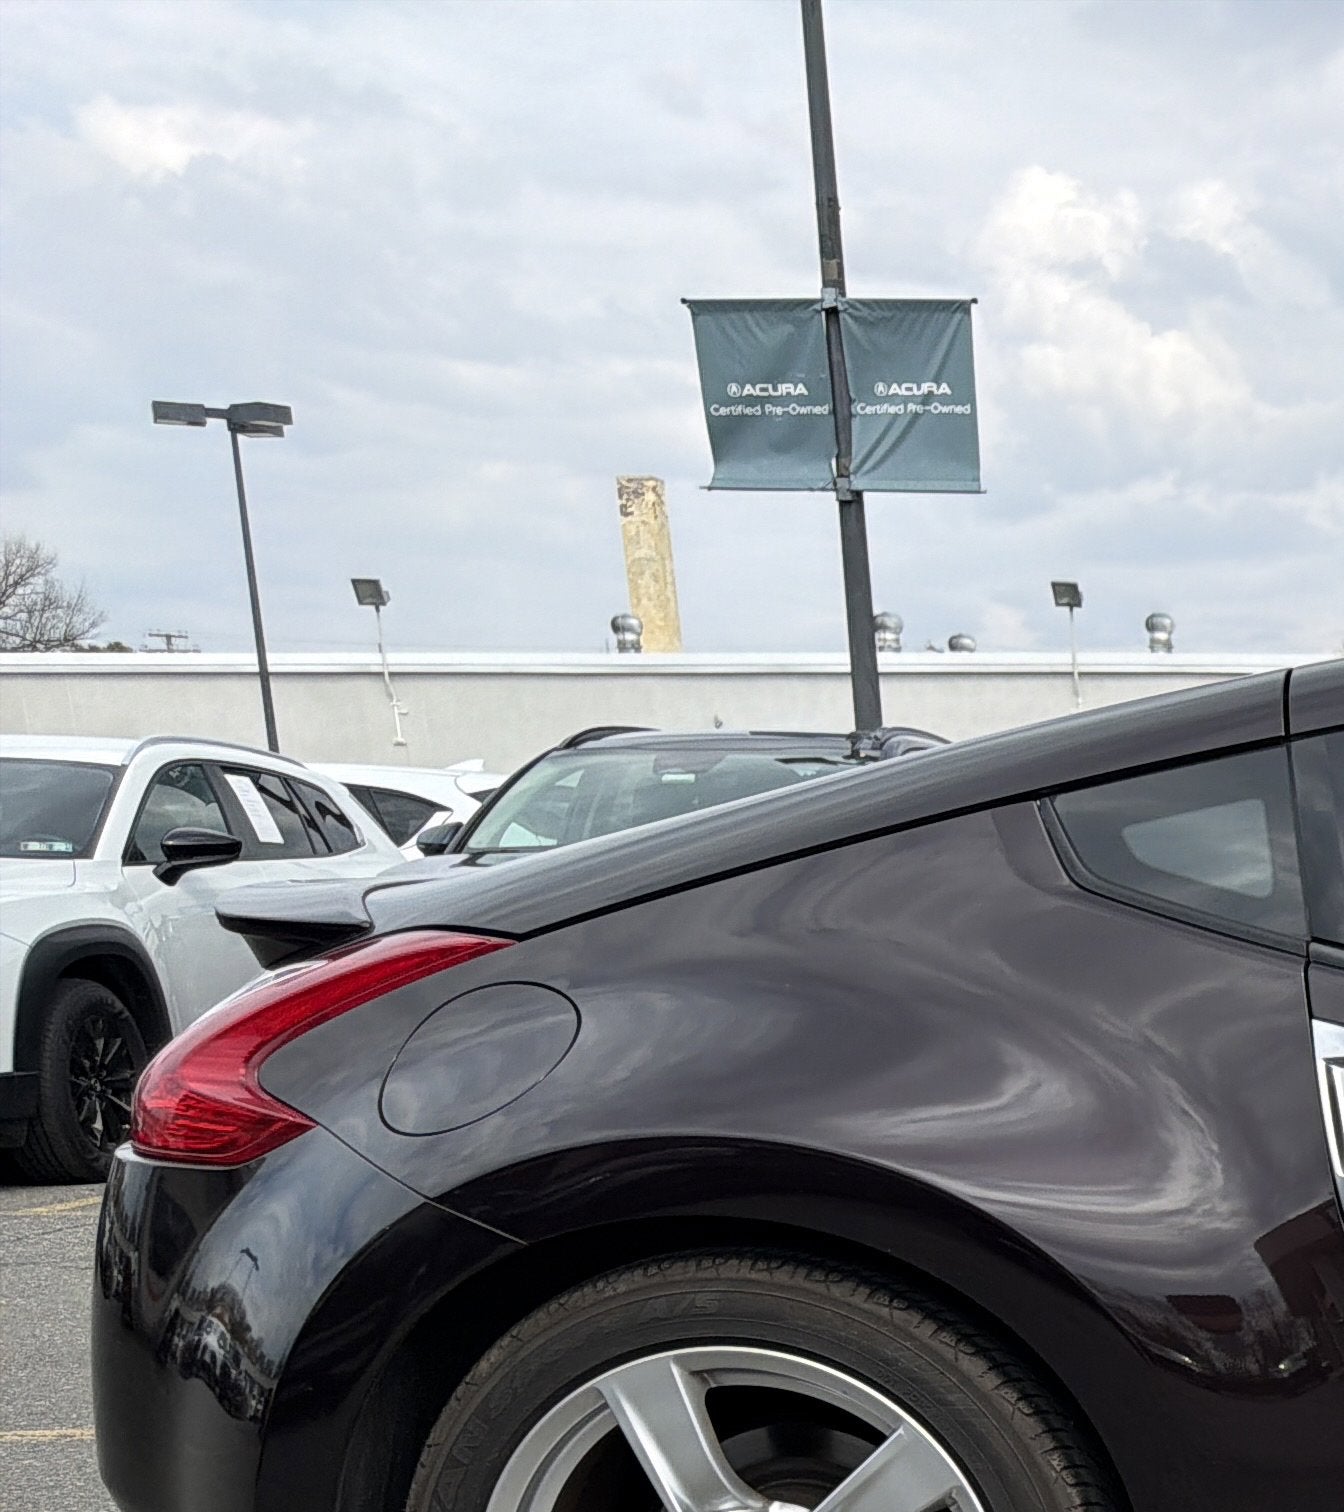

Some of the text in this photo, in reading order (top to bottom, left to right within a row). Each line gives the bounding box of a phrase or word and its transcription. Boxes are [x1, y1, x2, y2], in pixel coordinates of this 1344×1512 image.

[742, 383, 809, 397] ACURA
[887, 382, 952, 396] ACURA
[710, 403, 829, 416] Certified Pre-Owned
[856, 402, 972, 416] Certified Pre-Owned
